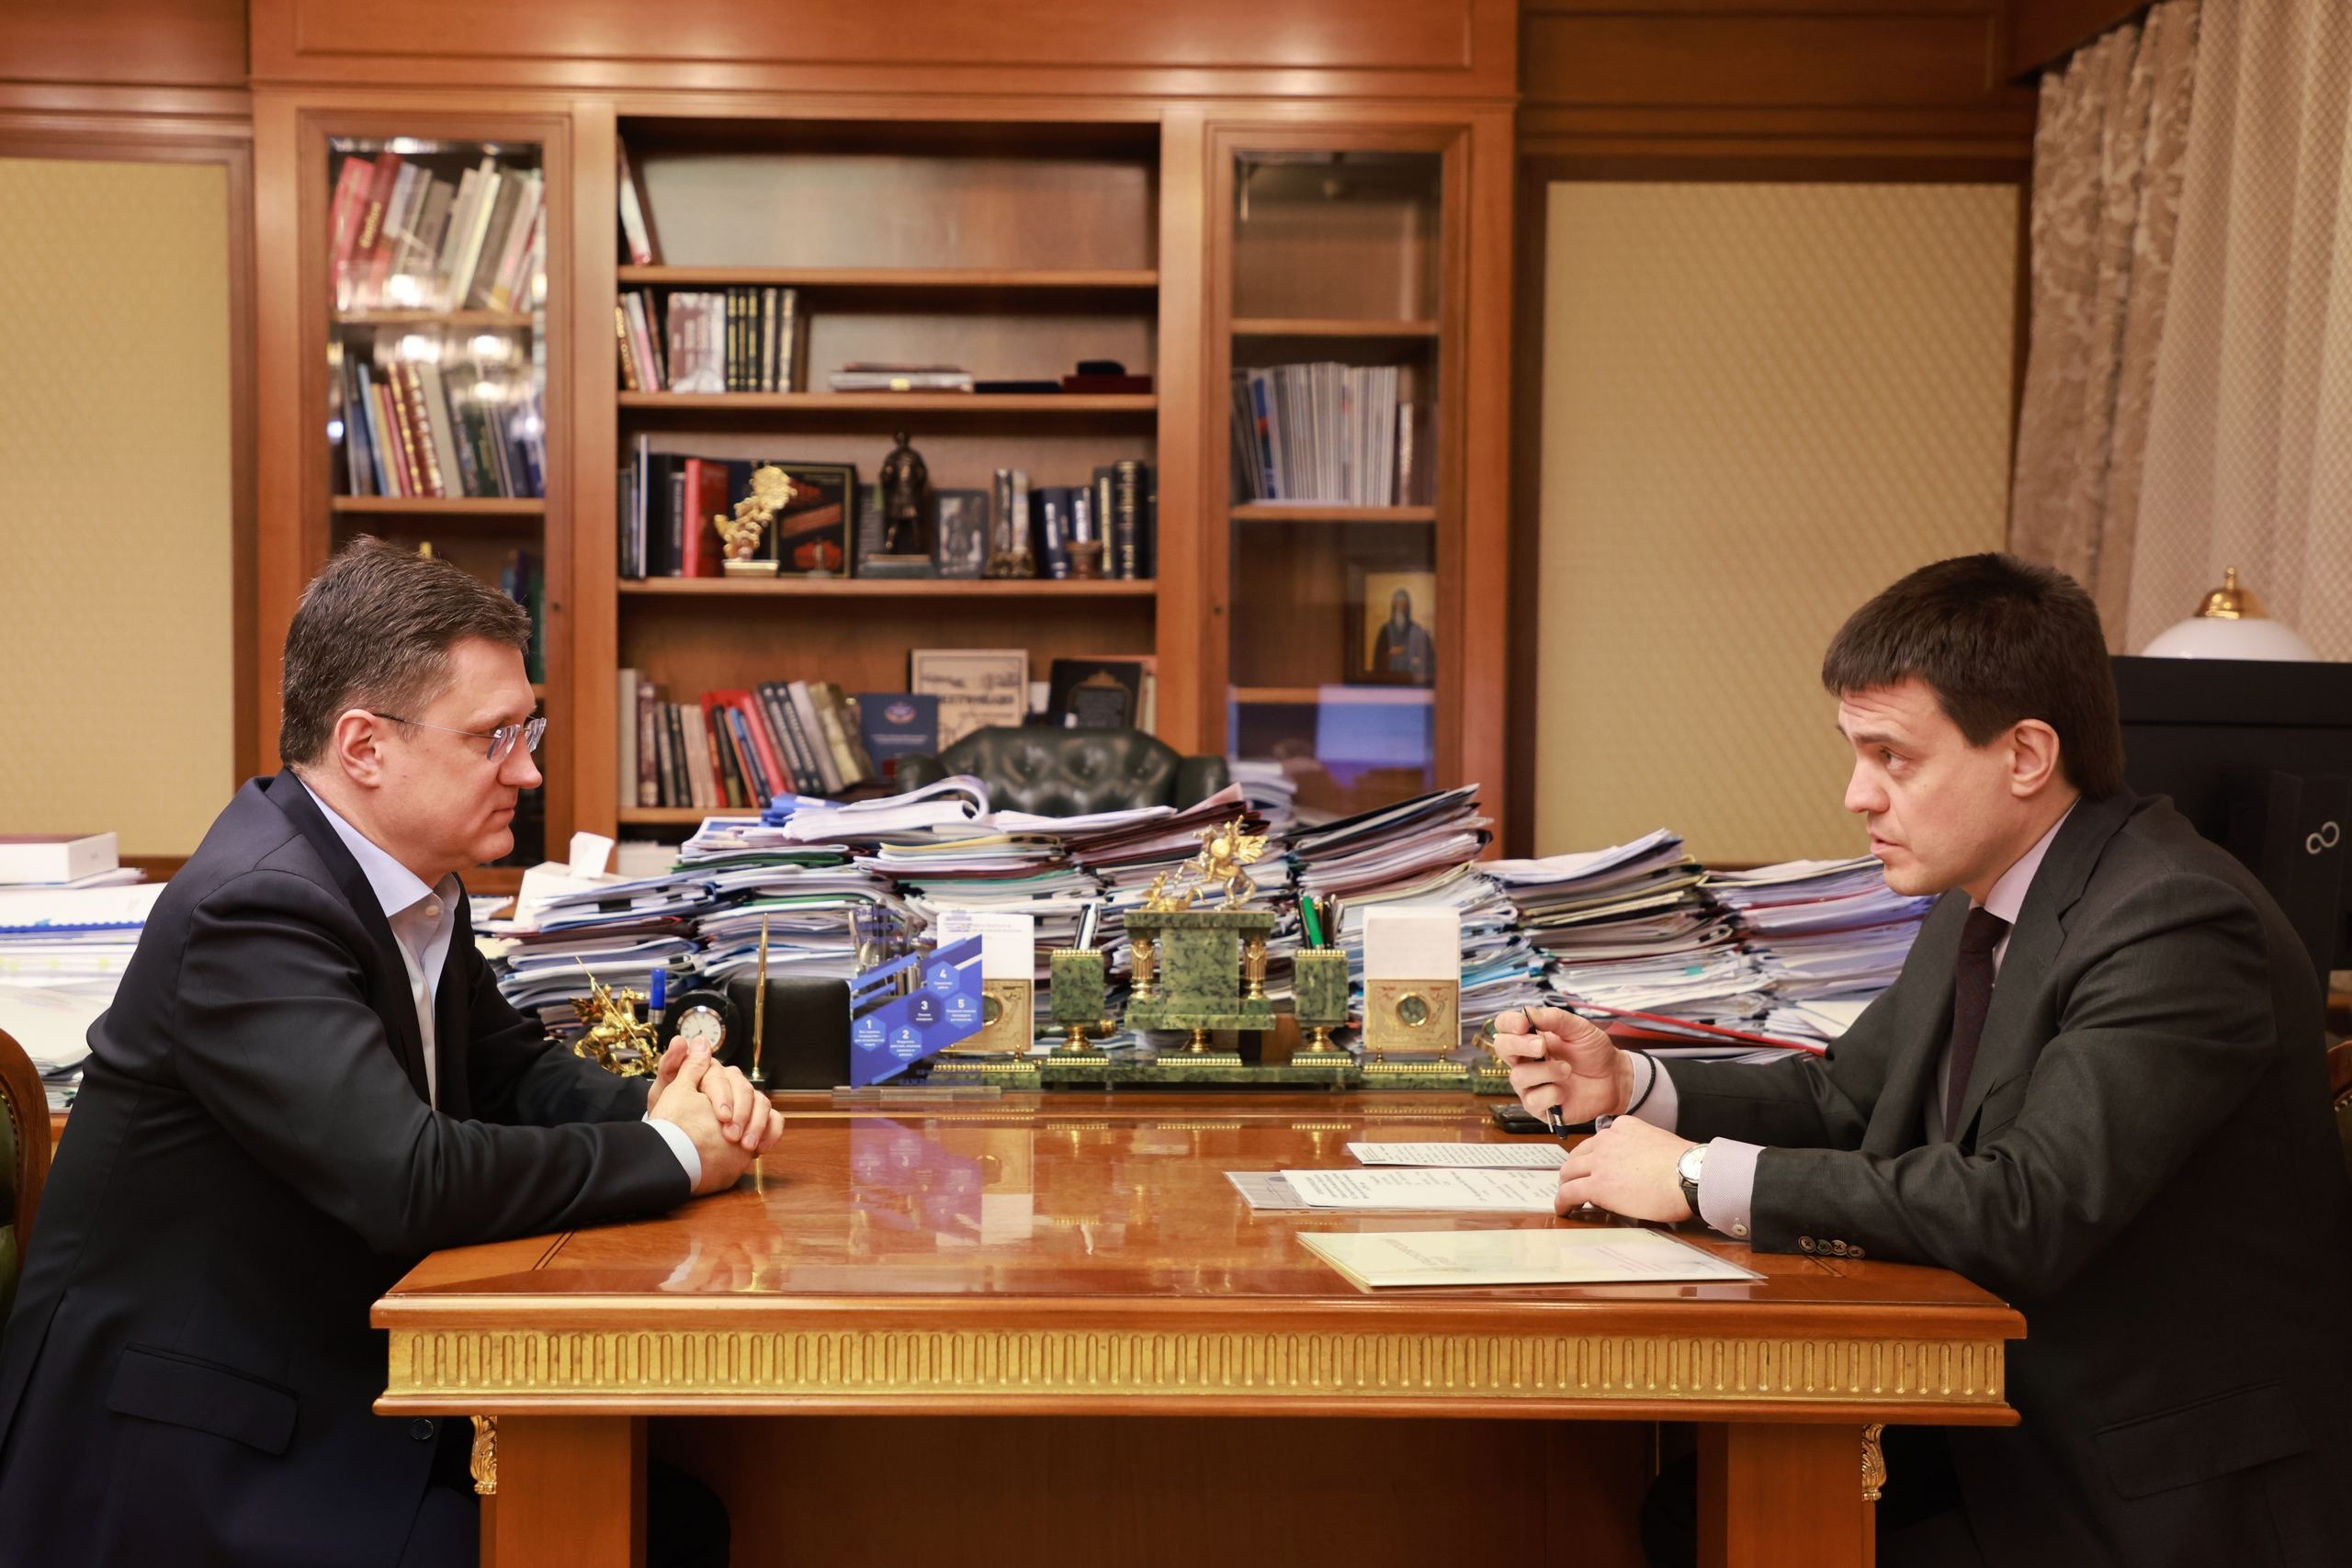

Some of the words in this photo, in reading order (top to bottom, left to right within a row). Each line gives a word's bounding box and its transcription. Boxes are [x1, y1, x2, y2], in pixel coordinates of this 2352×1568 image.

[939, 968, 947, 978] 4
[921, 1000, 928, 1010] 3
[957, 998, 965, 1009] 5
[865, 1020, 872, 1029] 1
[902, 1030, 910, 1039] 2
